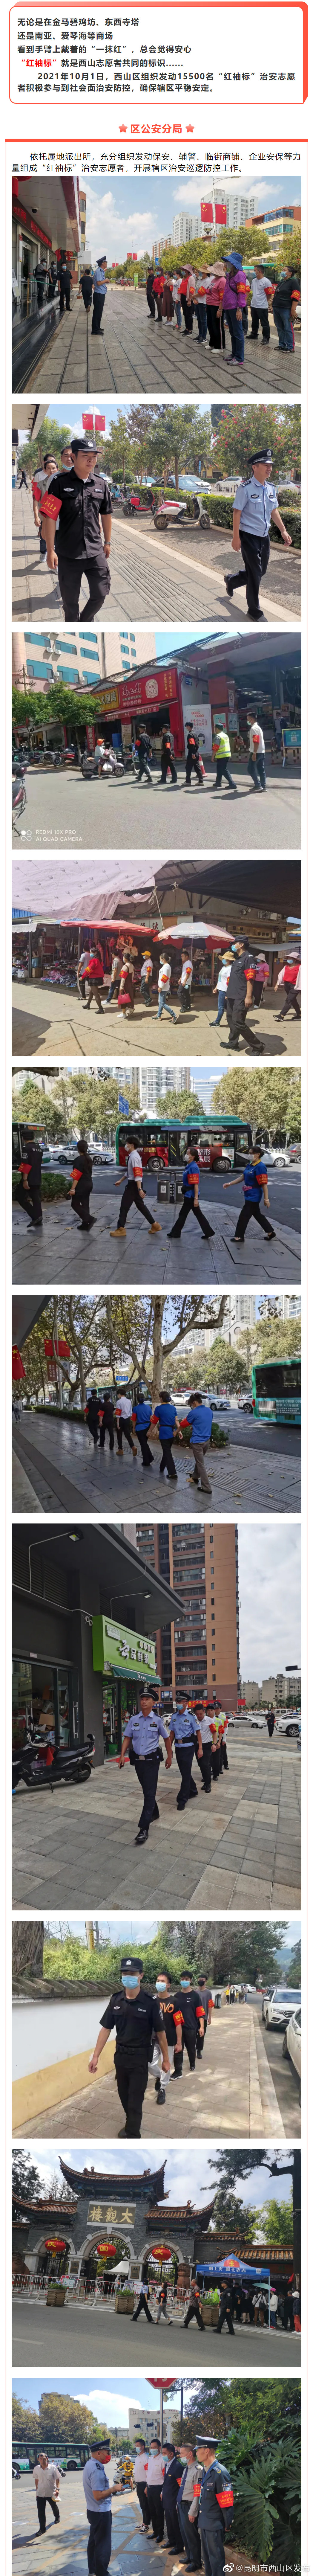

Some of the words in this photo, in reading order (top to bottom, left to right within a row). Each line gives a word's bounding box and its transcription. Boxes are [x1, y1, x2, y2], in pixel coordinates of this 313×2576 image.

[43, 500, 56, 511] 安志愿者
[96, 691, 116, 705] 火腿鸡
[89, 2205, 133, 2223] 大觀樓
